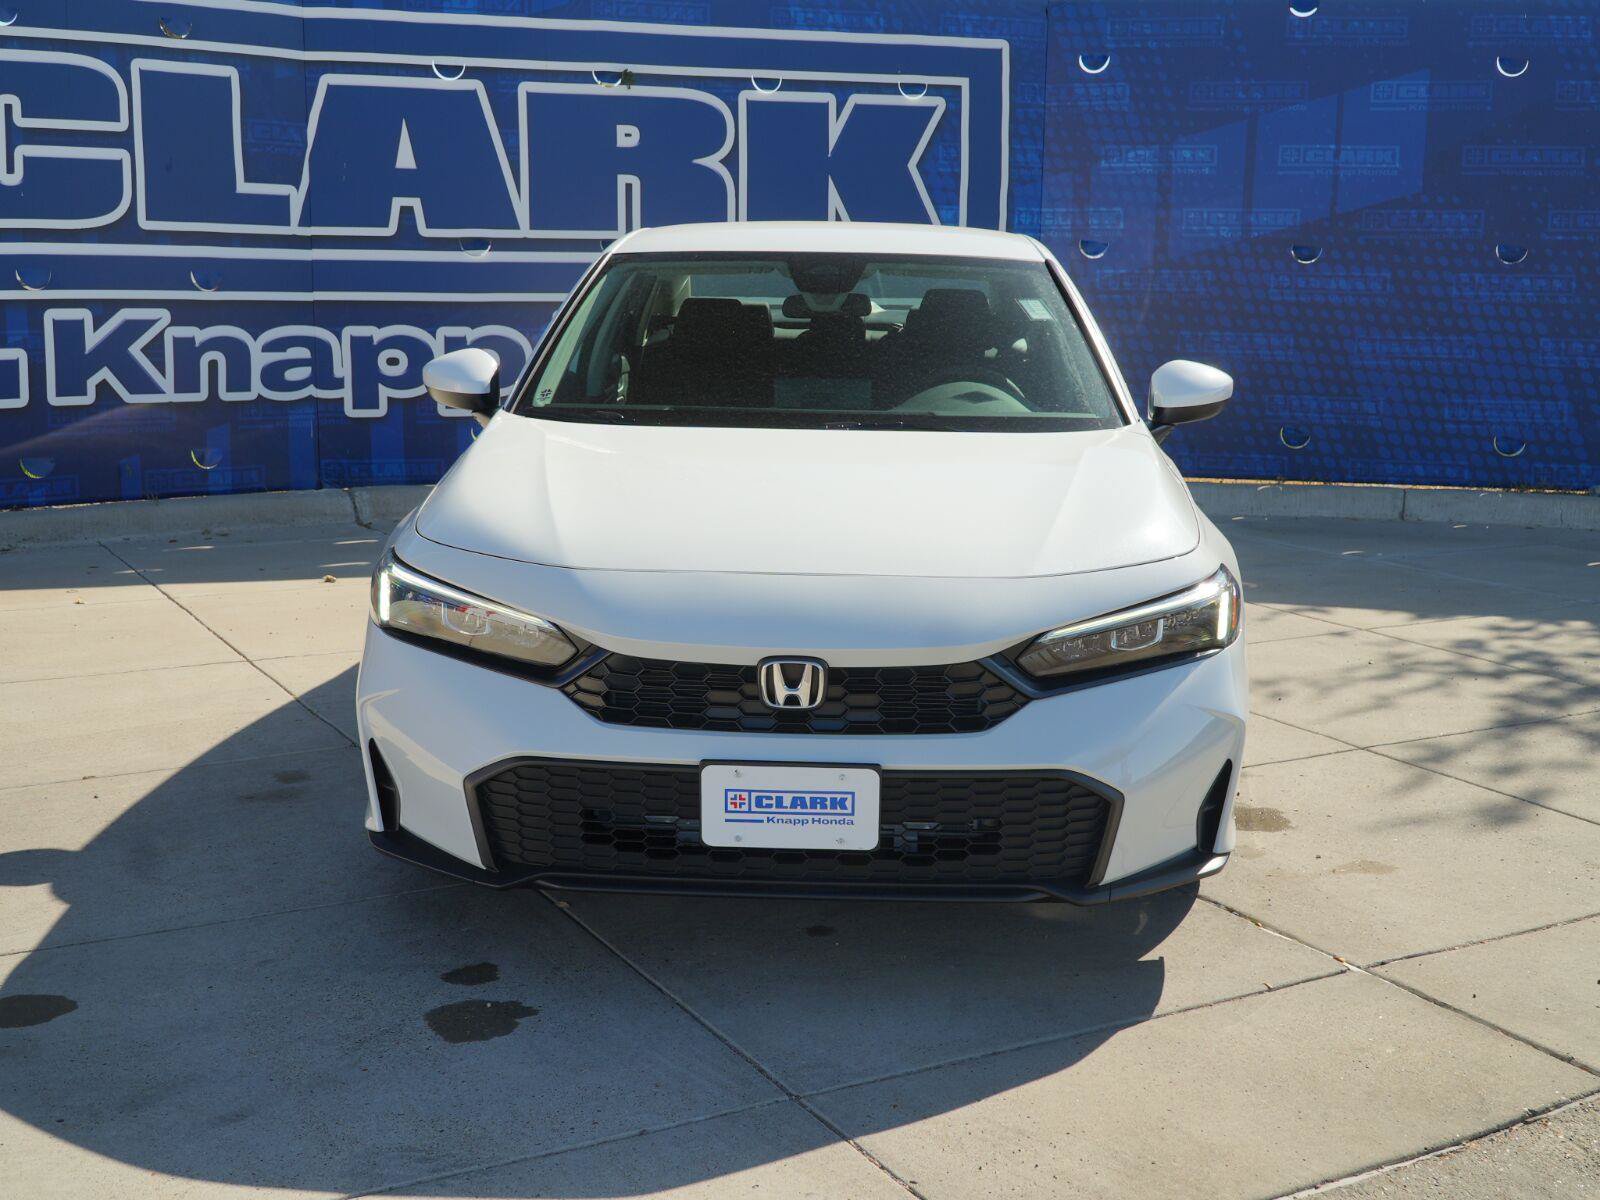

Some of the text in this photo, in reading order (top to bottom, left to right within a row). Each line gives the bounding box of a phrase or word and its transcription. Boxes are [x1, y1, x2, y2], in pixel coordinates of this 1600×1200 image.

[0, 48, 947, 239] CLARK
[44, 308, 534, 417] Knapp
[755, 795, 848, 810] CLARK
[766, 816, 854, 827] Knapp Honda
